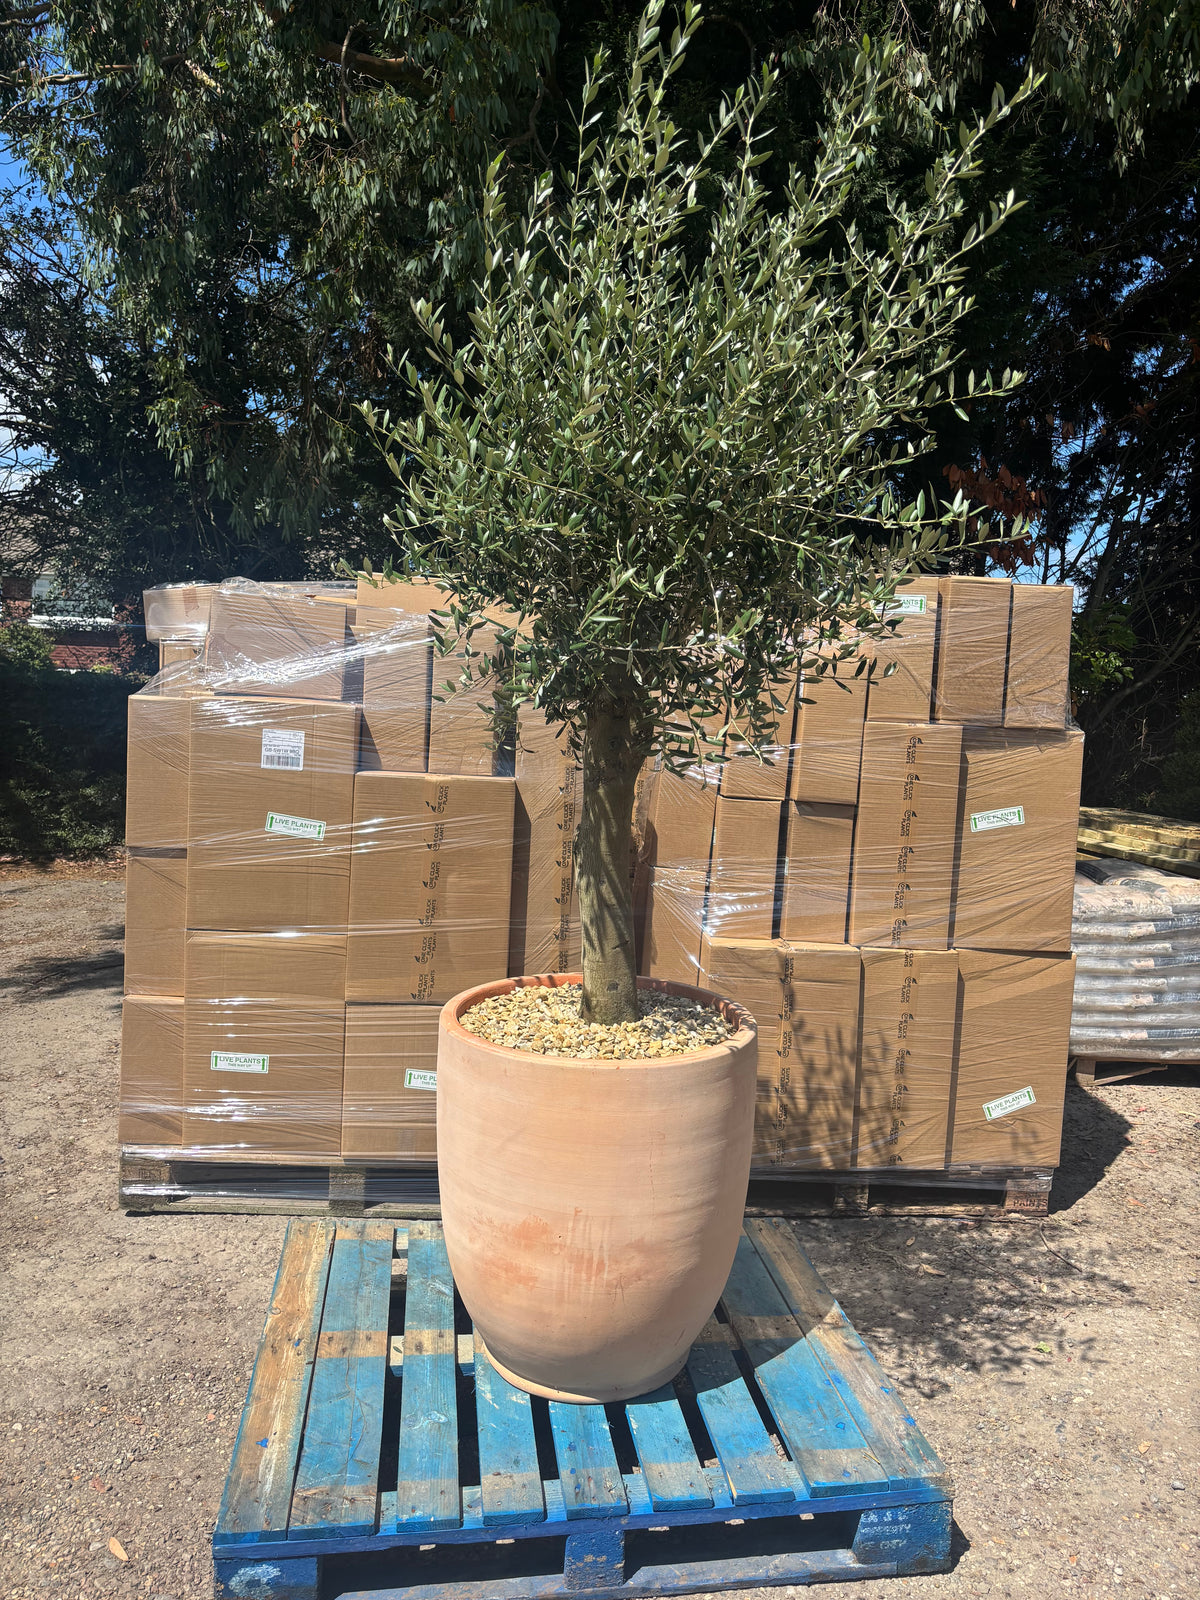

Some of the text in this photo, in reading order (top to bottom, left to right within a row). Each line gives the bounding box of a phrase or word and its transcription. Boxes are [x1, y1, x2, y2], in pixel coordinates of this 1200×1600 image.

[275, 818, 318, 830] LIVE PLANTS
[413, 1073, 428, 1081] LIVE
[991, 1093, 1027, 1111] LIVE PLANTS
